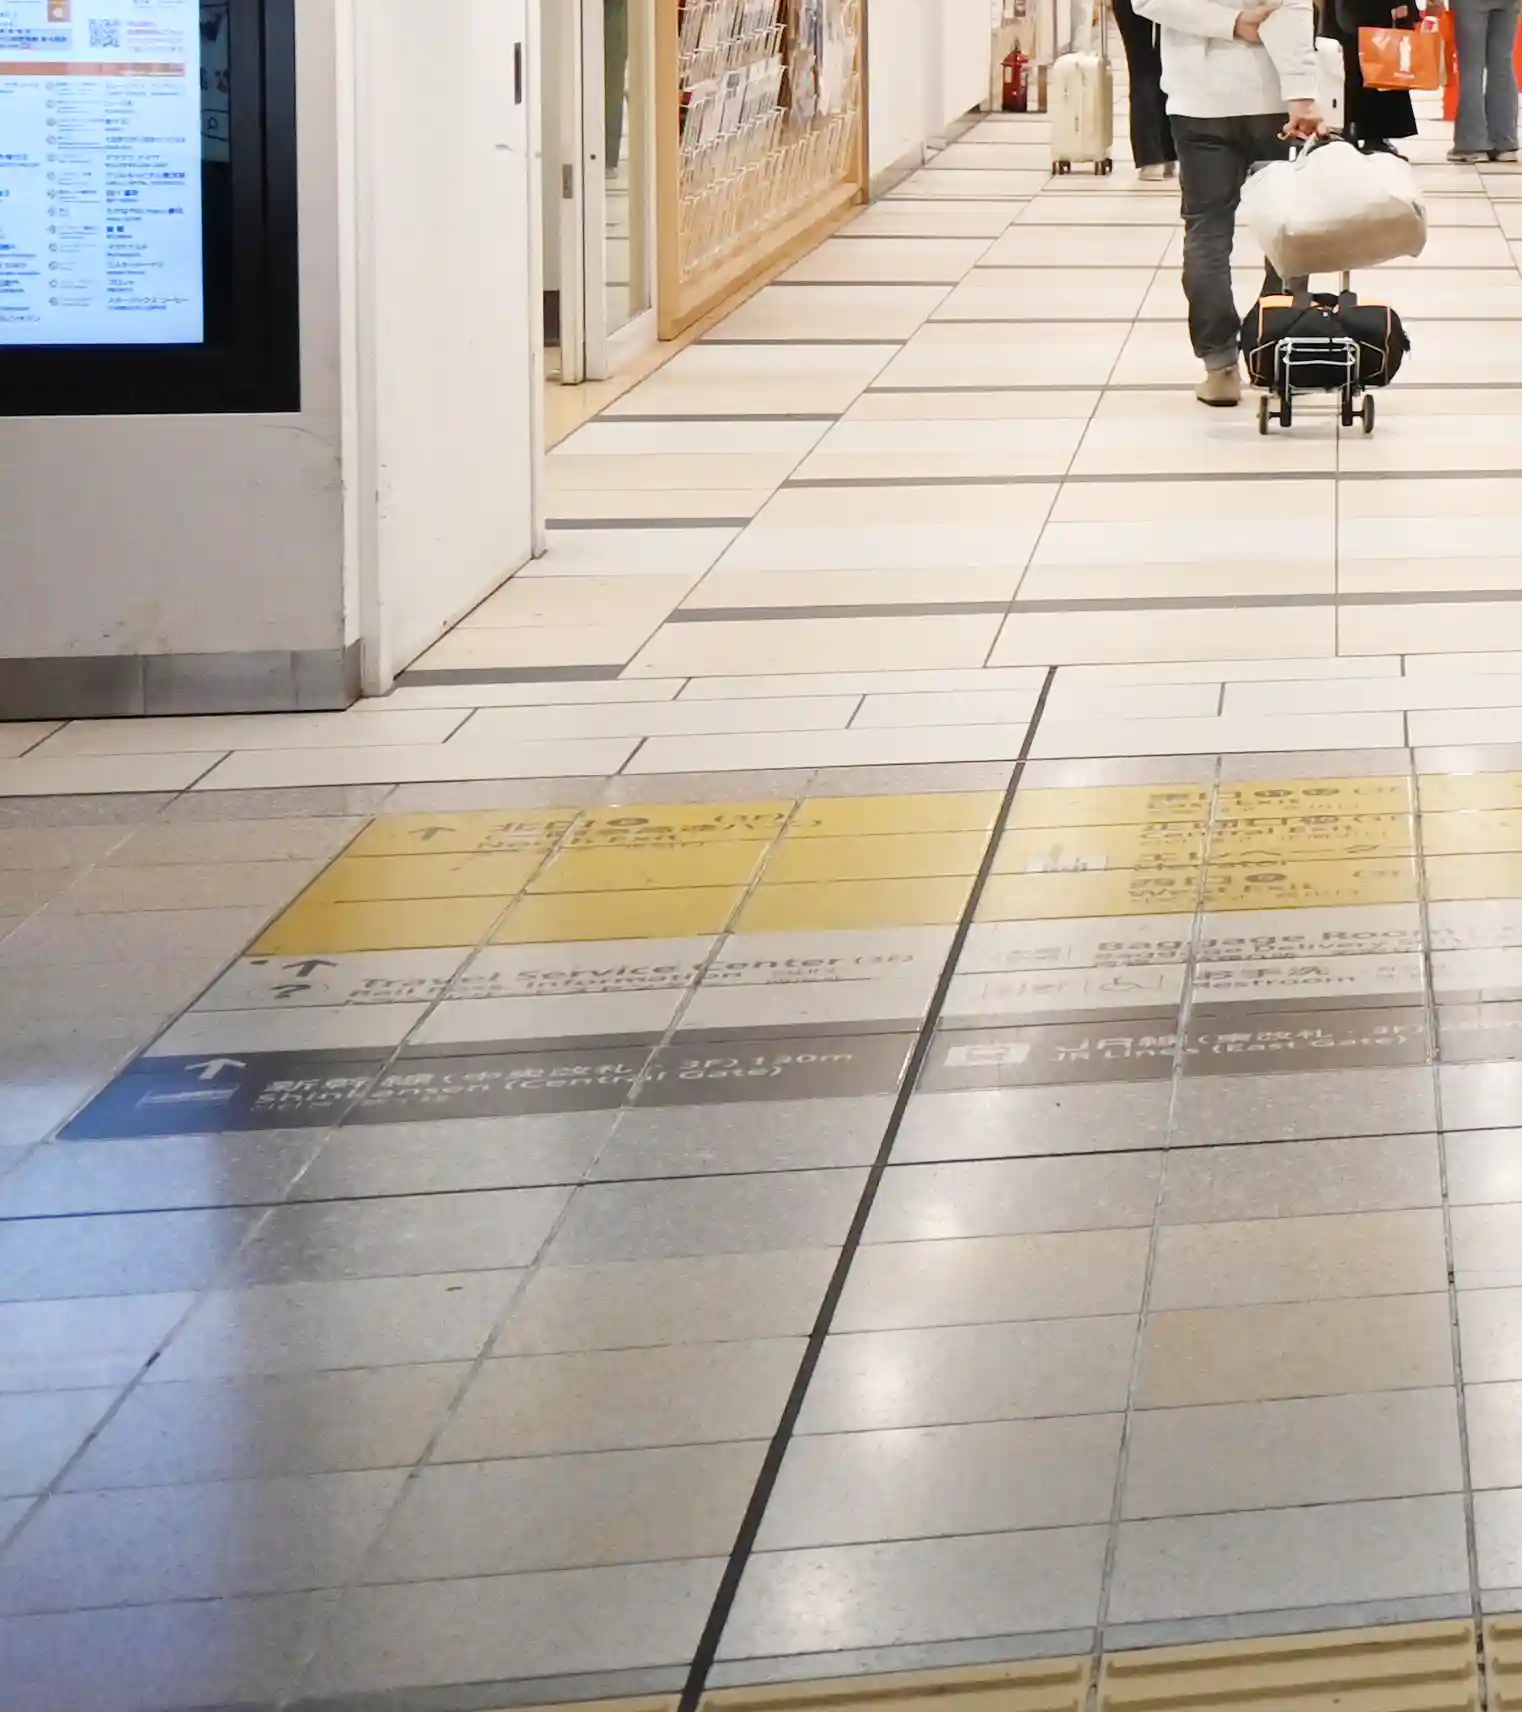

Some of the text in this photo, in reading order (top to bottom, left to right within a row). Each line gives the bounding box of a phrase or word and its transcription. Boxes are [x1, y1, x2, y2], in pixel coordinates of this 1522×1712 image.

[1098, 935, 1306, 951] Baggage
[361, 971, 501, 988] Travel
[516, 966, 676, 980] Service
[692, 958, 843, 972] Center
[523, 972, 745, 988] Information
[1310, 1036, 1408, 1048] Gate)
[678, 1065, 784, 1080] Gate)
